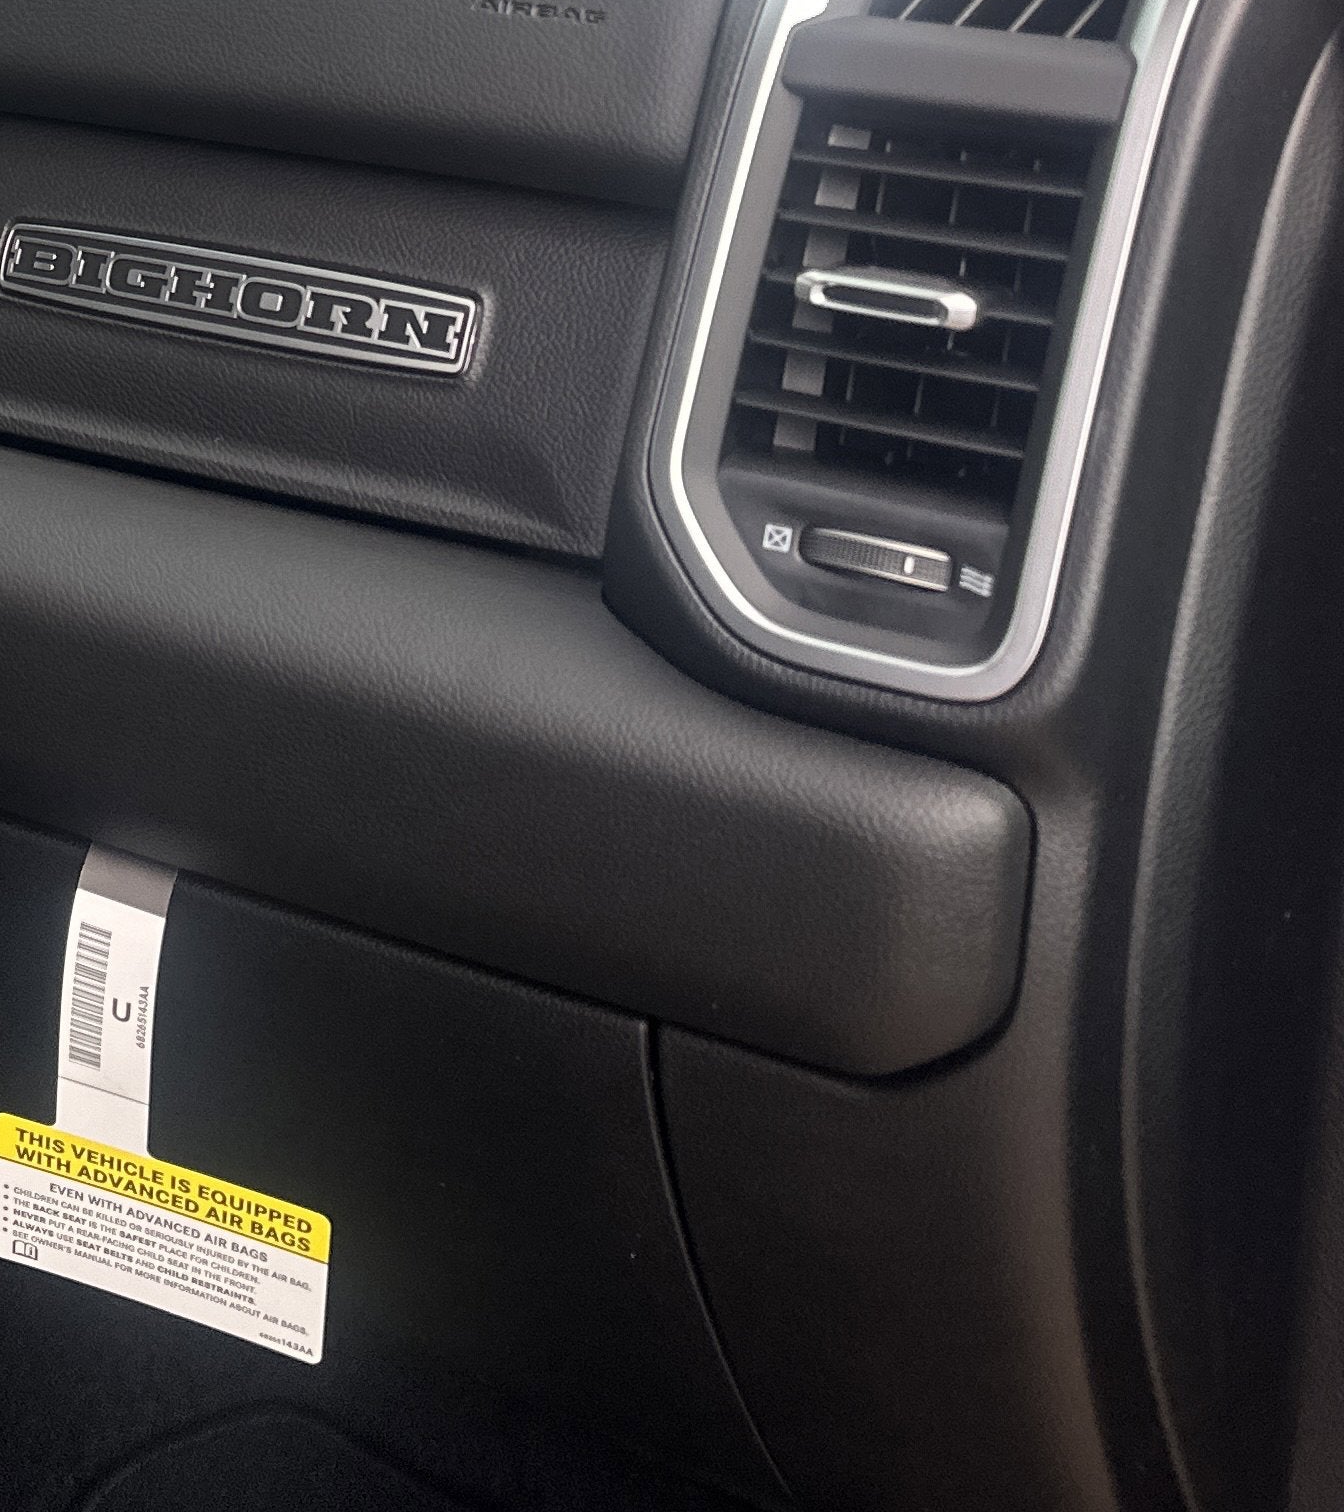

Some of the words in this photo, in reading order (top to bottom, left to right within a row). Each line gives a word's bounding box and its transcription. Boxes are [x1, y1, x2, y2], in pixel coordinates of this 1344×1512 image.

[7, 235, 463, 360] BIGHORN
[135, 986, 150, 1049] 68265143AA
[15, 1126, 64, 1154] THIS
[70, 1144, 163, 1185] VEHICLE
[170, 1175, 190, 1194] IS
[197, 1184, 312, 1235] EQUIPPED
[15, 1144, 70, 1174] WITH
[77, 1163, 199, 1214] ADVANCED
[205, 1204, 243, 1229] AIR
[250, 1220, 310, 1252] BAGS
[49, 1182, 83, 1201] EVEN
[87, 1194, 122, 1213] WITH
[126, 1206, 200, 1239] ADVANCED
[204, 1232, 227, 1248] AIR
[230, 1241, 267, 1262] BAGS
[12, 1218, 54, 1238] ALWAYS
[56, 1232, 73, 1244] USE
[76, 1238, 101, 1253] SEAT
[103, 1247, 133, 1263] BELTS
[135, 1257, 155, 1270] AND
[157, 1265, 188, 1282] CHILD
[191, 1277, 256, 1305] RESTRAINTS.
[12, 1229, 28, 1240] SEE
[74, 1249, 112, 1267] MANUAL
[114, 1262, 132, 1274] FOR
[134, 1268, 161, 1284] MORE
[163, 1278, 227, 1306] INFORMATION
[228, 1301, 260, 1319] ABOUT
[262, 1313, 279, 1325] AIR
[280, 1319, 309, 1336] BAGS.
[13, 1186, 58, 1206] CHILDREN
[60, 1200, 79, 1212] CAN
[82, 1207, 93, 1217] BE
[95, 1211, 126, 1227] KILLED
[128, 1221, 142, 1232] OR
[144, 1227, 194, 1250] SERIOUSLY
[196, 1244, 234, 1264] INJURED
[237, 1258, 249, 1269] BY
[251, 1263, 269, 1276] THE
[271, 1270, 287, 1282] AIR
[289, 1276, 312, 1291] BAG.
[13, 1197, 30, 1208] THE
[32, 1203, 59, 1217] BACK
[62, 1212, 86, 1226] SEAT
[88, 1220, 97, 1229] IS
[100, 1224, 116, 1235] THE
[119, 1230, 156, 1248] SAFEST
[158, 1242, 187, 1259] PLACE
[189, 1253, 208, 1266] FOR
[210, 1260, 261, 1284] CHILDREN.
[13, 1207, 45, 1224] NEVER
[48, 1218, 65, 1230] PUT
[67, 1225, 74, 1233] A
[136, 1246, 164, 1262] CHILD
[166, 1256, 188, 1271] SEAT
[191, 1265, 201, 1275] IN
[204, 1269, 221, 1282] THE
[223, 1276, 256, 1294] FRONT.
